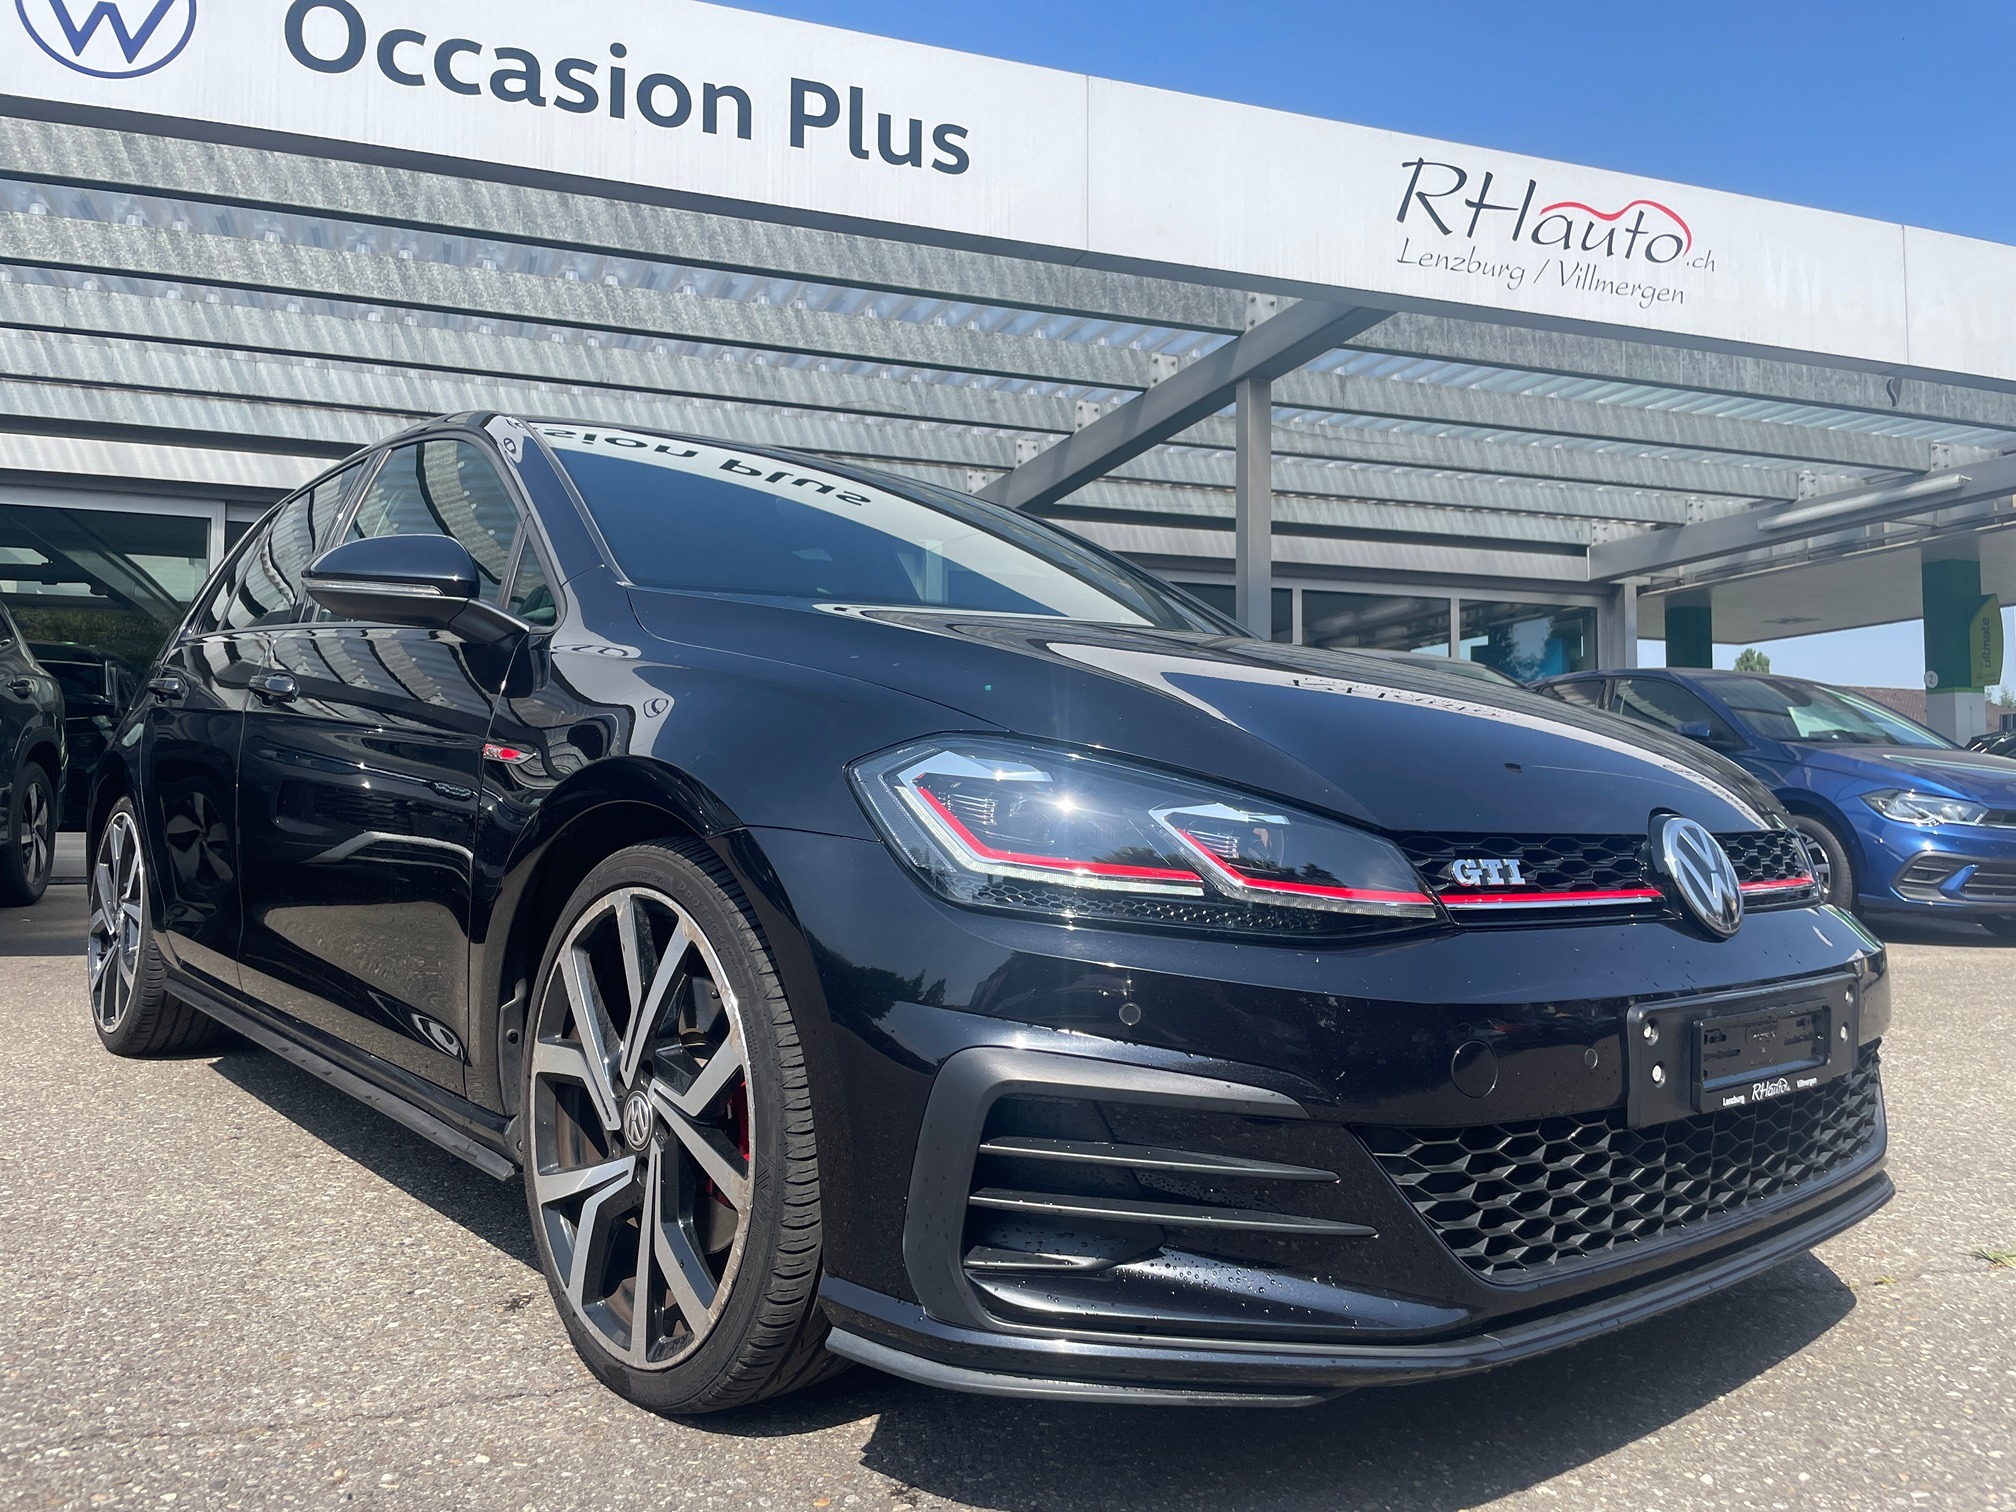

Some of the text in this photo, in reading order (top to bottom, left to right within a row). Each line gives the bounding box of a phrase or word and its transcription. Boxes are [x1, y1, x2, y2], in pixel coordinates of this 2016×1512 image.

[284, 0, 970, 175] Occasion Plus
[1397, 237, 1525, 290] Lenzburg
[1558, 259, 1685, 309] Villmergen
[1980, 616, 1991, 668] ultimate
[1928, 674, 1935, 684] 2
[1451, 857, 1526, 886] GTI
